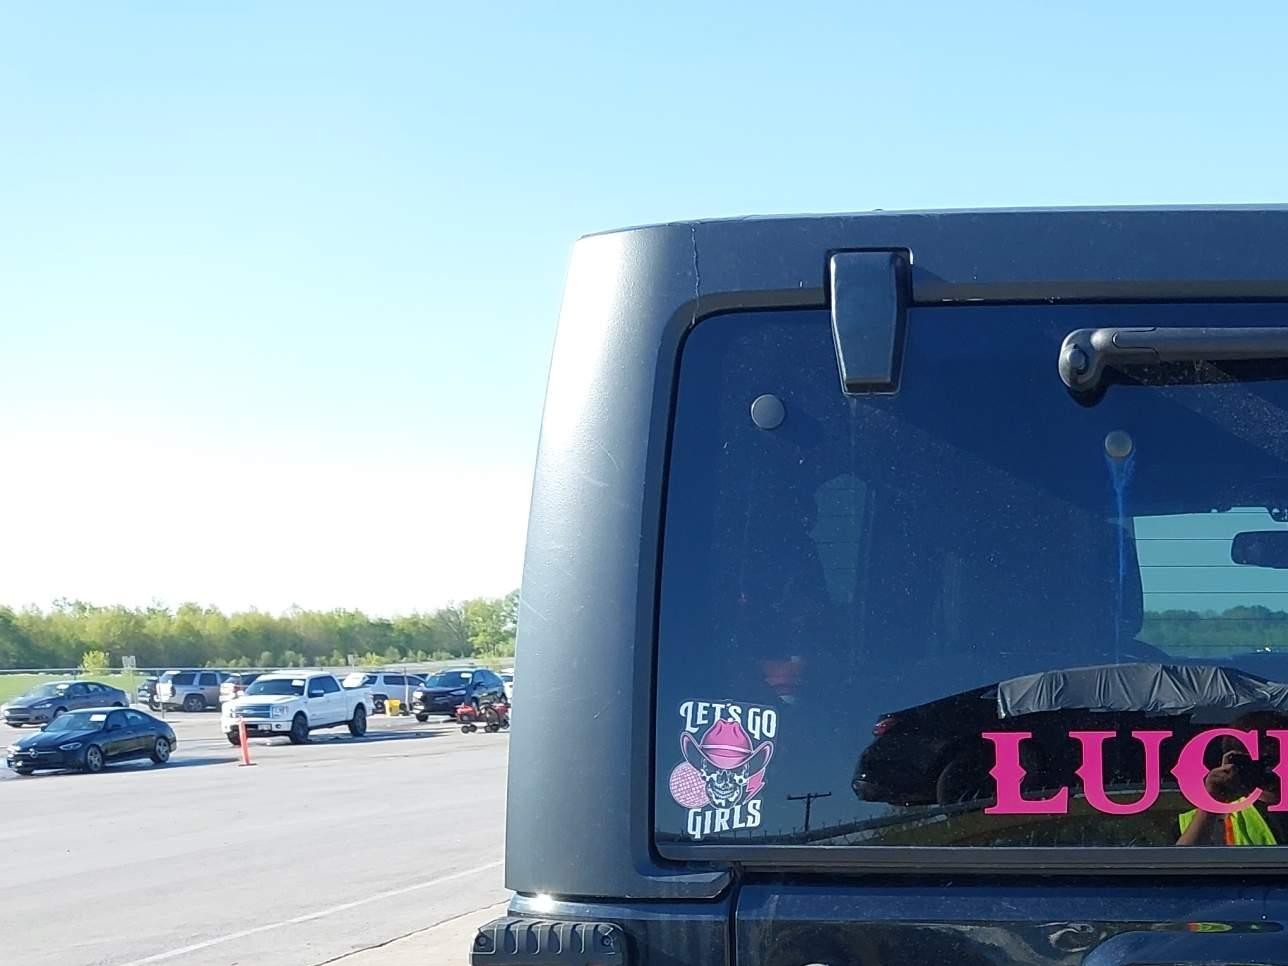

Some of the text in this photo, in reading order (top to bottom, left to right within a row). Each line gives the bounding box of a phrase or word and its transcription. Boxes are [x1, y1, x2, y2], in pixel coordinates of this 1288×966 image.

[679, 701, 777, 740] LET'S GO
[687, 799, 762, 839] GIRLS
